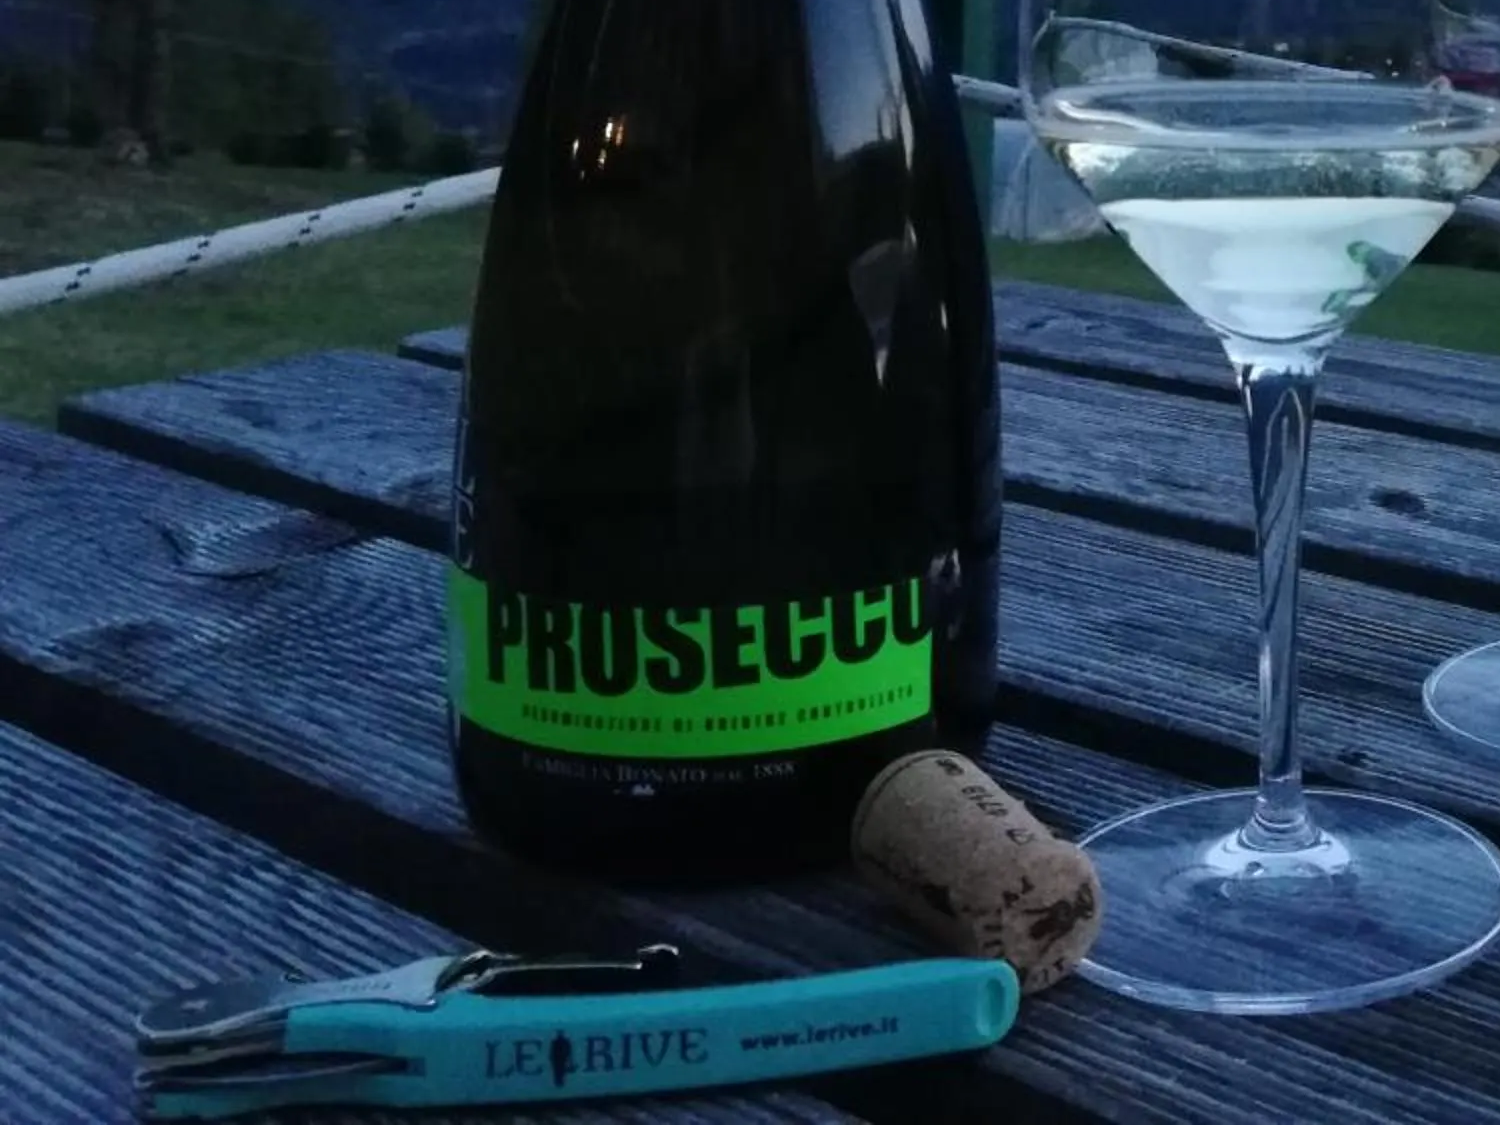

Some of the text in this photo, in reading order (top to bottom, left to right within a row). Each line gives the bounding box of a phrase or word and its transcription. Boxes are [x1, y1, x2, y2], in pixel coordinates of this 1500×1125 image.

[485, 574, 933, 698] PROSECCO
[484, 1027, 710, 1081] LE RIVE
[739, 1015, 899, 1052] www.lerive.it
